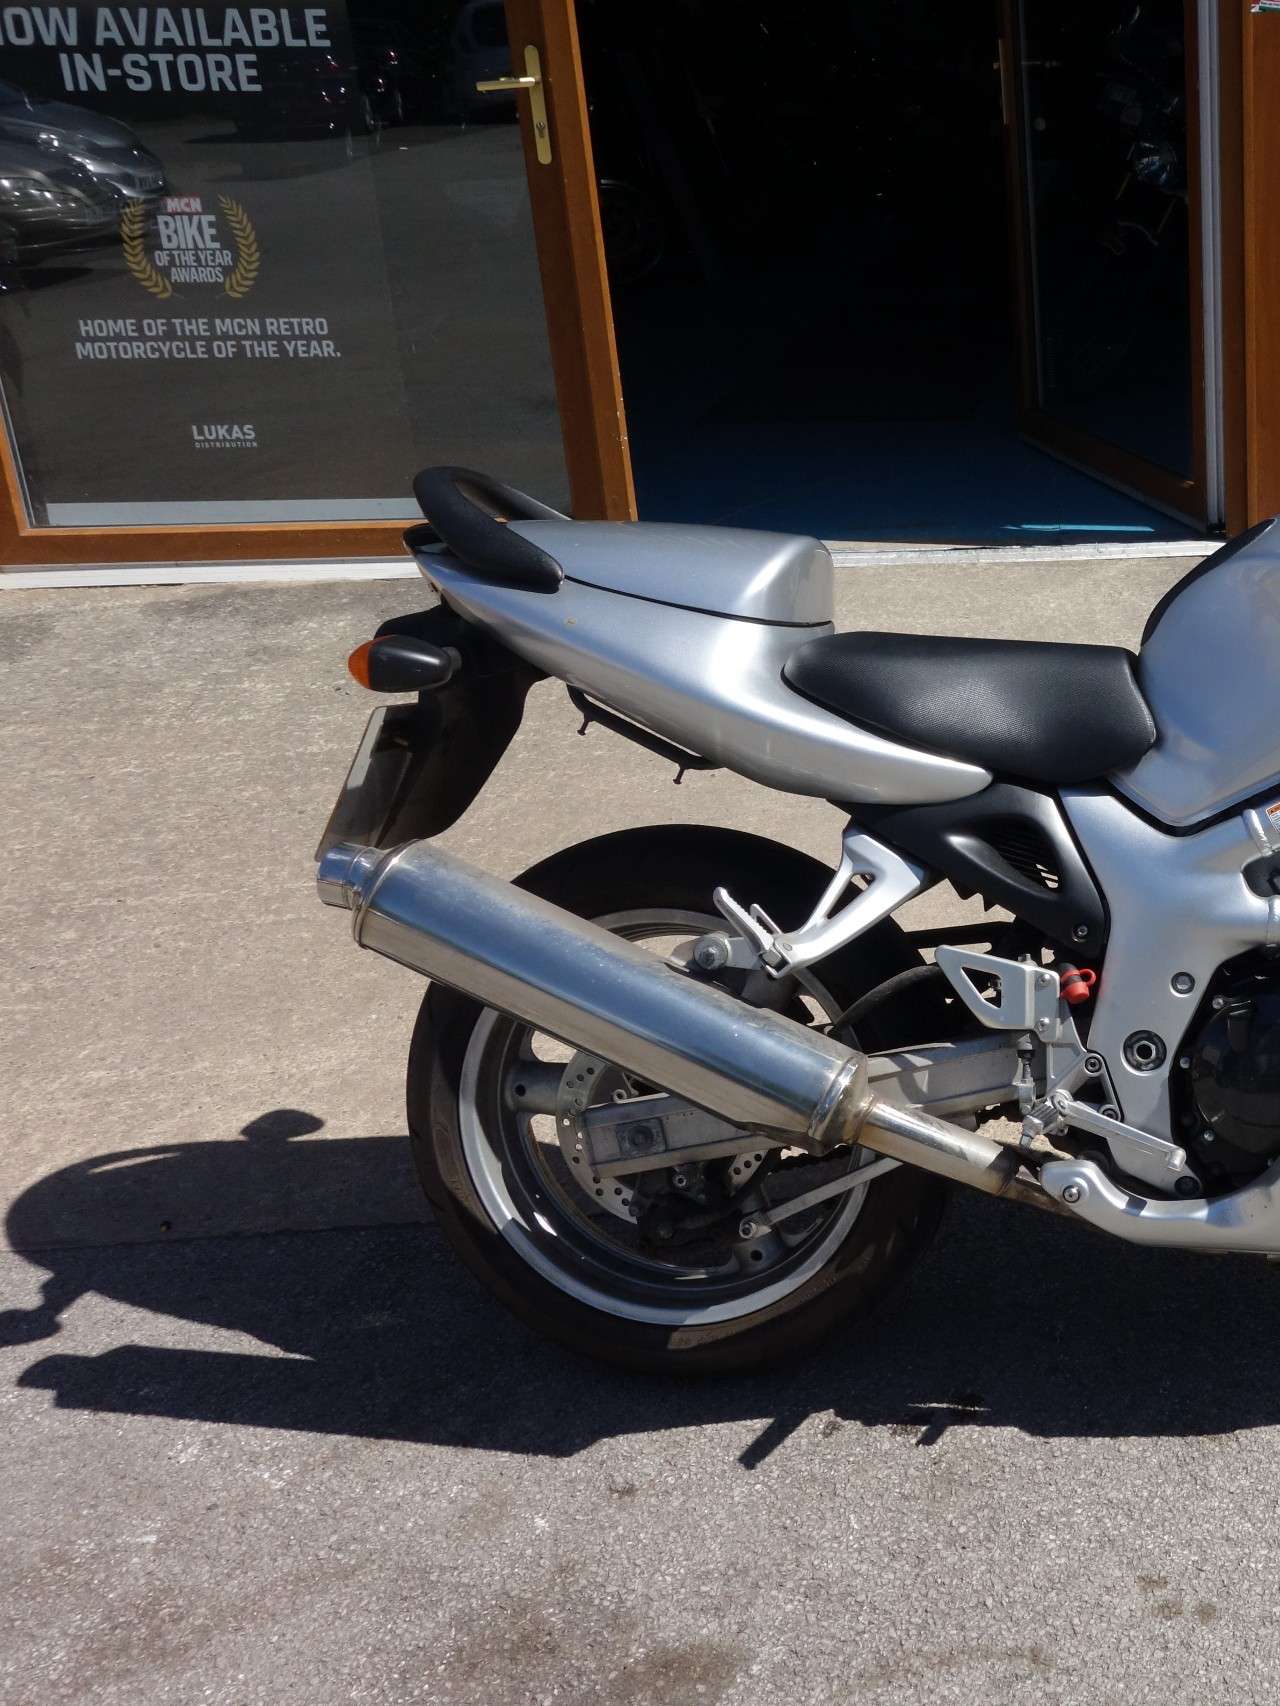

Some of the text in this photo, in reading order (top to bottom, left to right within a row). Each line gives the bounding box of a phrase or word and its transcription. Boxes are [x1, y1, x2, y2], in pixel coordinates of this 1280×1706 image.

[0, 6, 332, 48] OW AVAILABLE
[59, 53, 262, 93] IN-STORE
[167, 198, 203, 213] MCN
[157, 214, 221, 250] BIKE
[154, 250, 233, 267] OF THE YEAR
[171, 267, 225, 283] AWARDS
[79, 317, 329, 337] HOME OF THE MCN RETRO
[75, 339, 342, 359] MOTORCYCLE OF THE YEAR.
[192, 424, 256, 441] LUKAS
